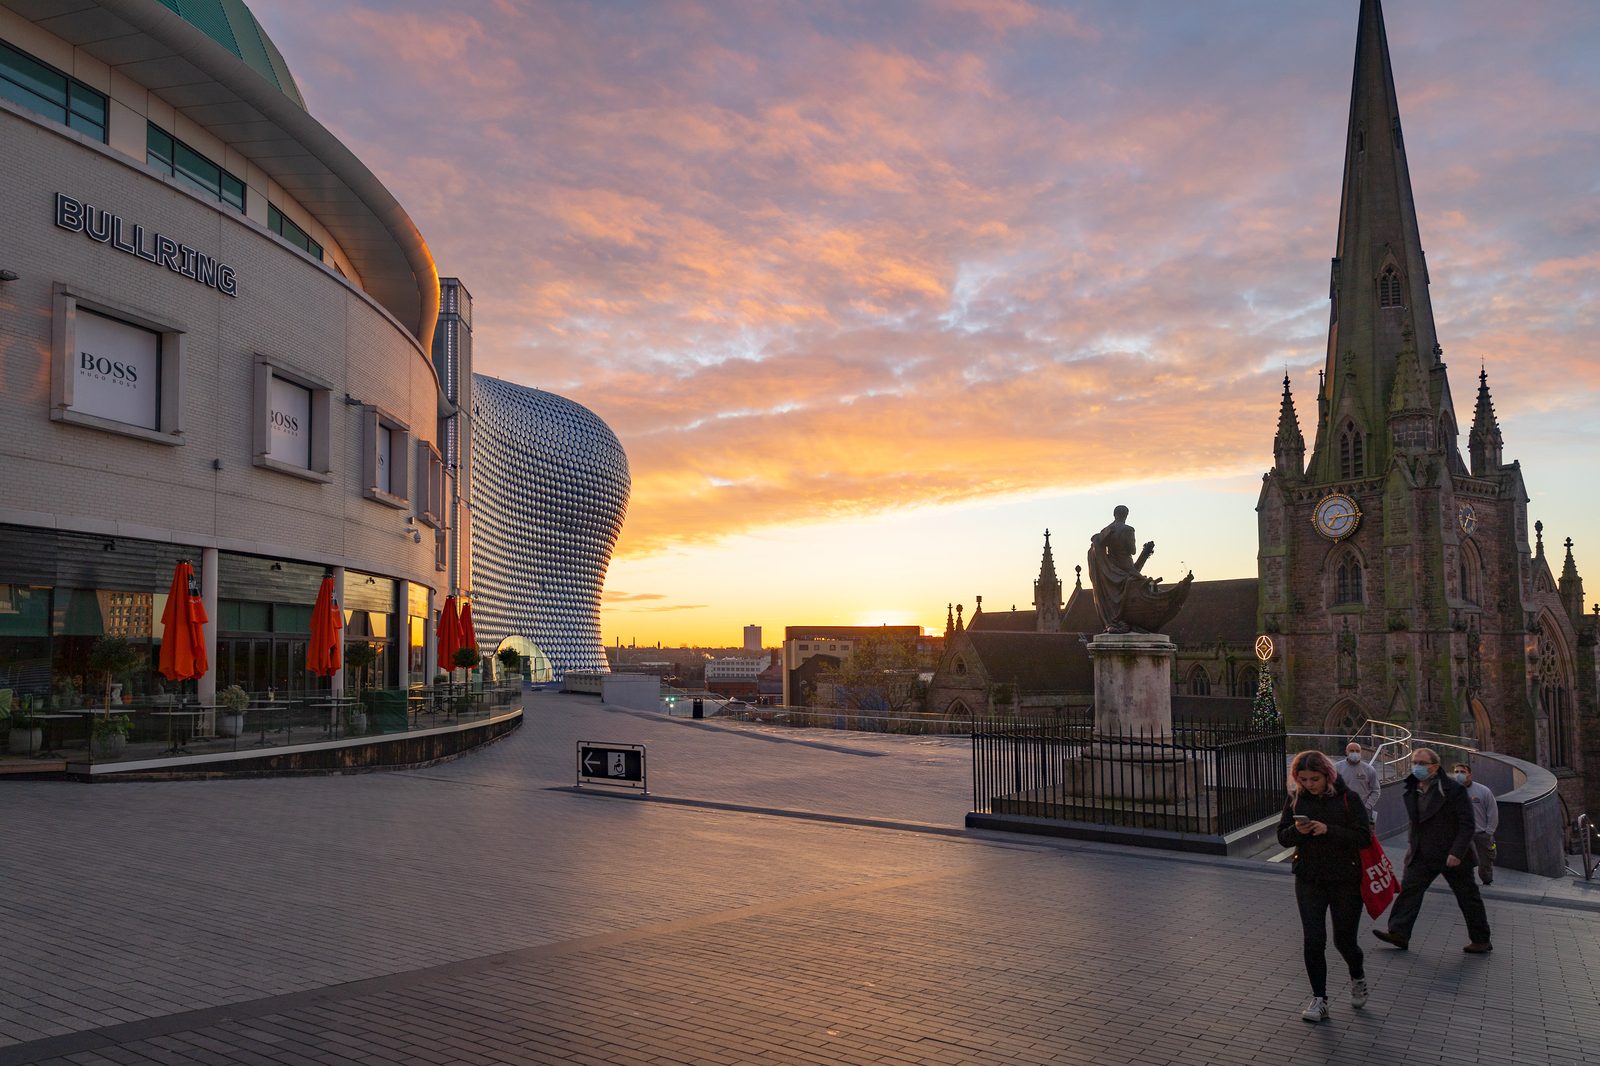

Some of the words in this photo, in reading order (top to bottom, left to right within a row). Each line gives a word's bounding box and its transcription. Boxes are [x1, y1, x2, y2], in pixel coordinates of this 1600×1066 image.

[55, 192, 238, 297] BULLRING
[80, 370, 106, 381] HUGO
[81, 352, 137, 382] BOSS
